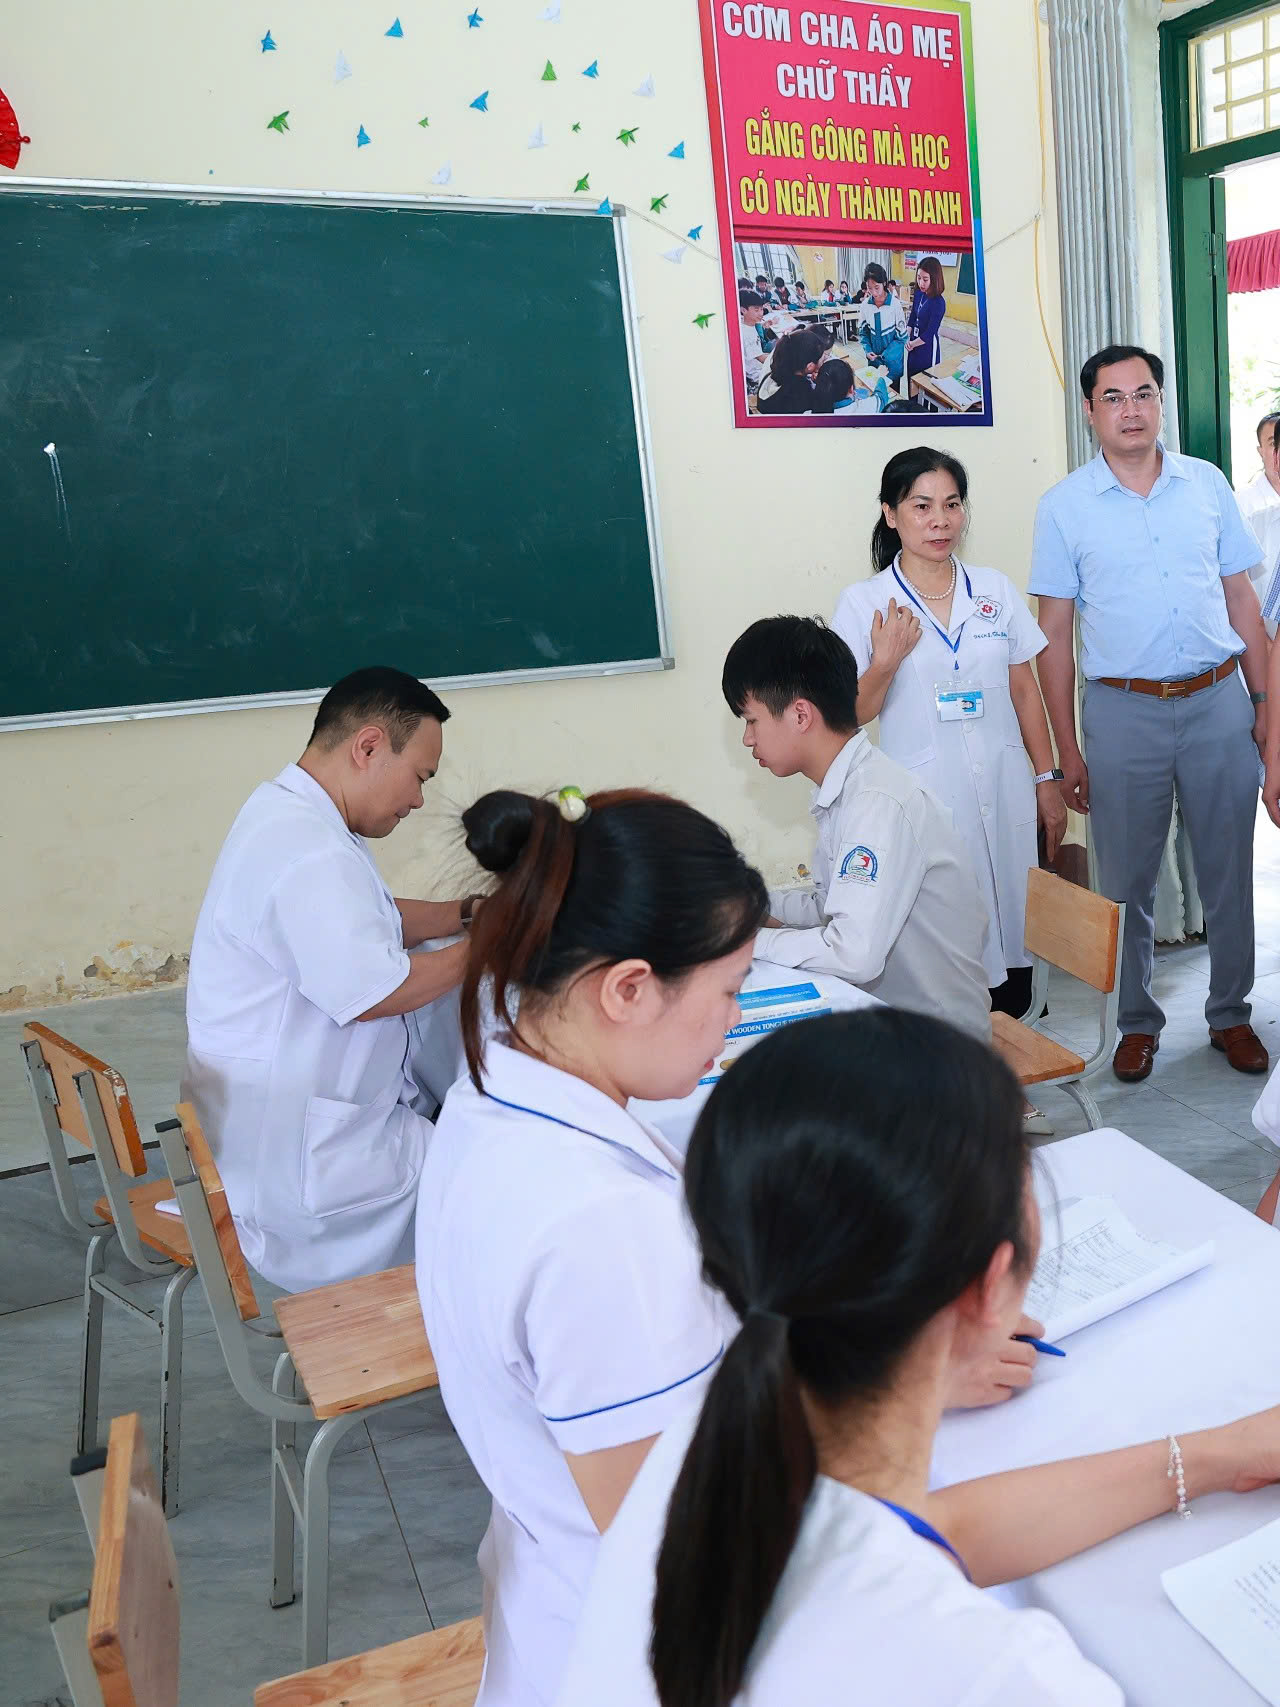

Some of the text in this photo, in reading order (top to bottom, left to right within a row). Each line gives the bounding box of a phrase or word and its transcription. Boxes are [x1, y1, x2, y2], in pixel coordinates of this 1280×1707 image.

[722, 1, 954, 68] CƠM CHA ÁO MẸ
[776, 58, 912, 109] CHỮ THẦY
[745, 107, 950, 177] GẮNG CÔNG MÀ HỌC
[739, 170, 963, 226] CÓ NGÀY THÀNH DANH
[731, 1024, 761, 1035] WOODEN
